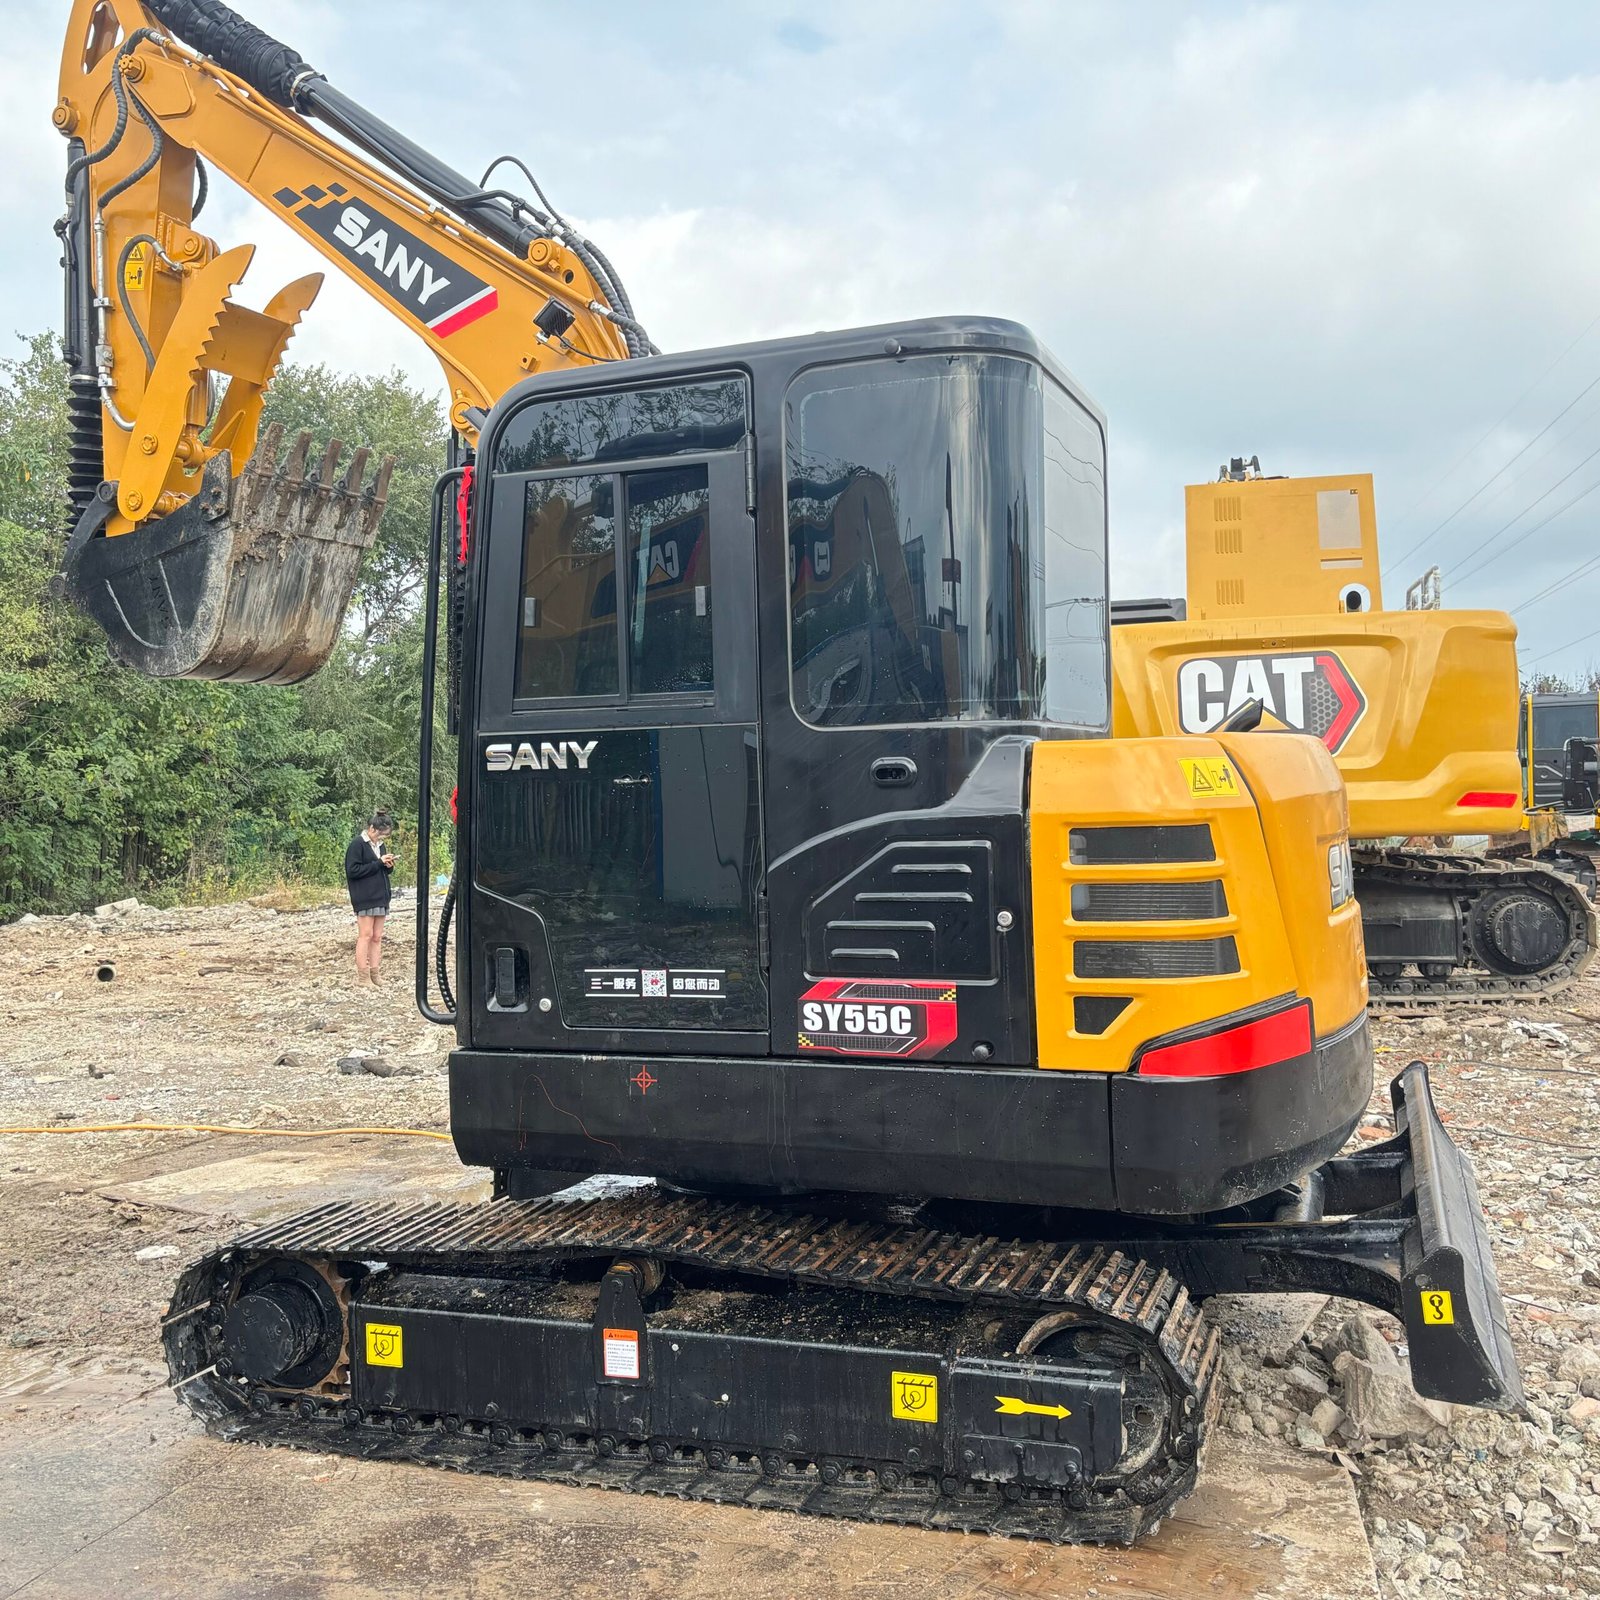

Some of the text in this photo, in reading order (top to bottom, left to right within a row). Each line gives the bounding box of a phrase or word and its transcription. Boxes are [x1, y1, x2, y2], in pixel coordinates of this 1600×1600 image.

[333, 206, 451, 306] SANY
[1180, 656, 1315, 734] CAT
[485, 740, 599, 771] SANY
[590, 977, 720, 991] 三一服务 因您而动
[802, 1002, 912, 1035] SY55C
